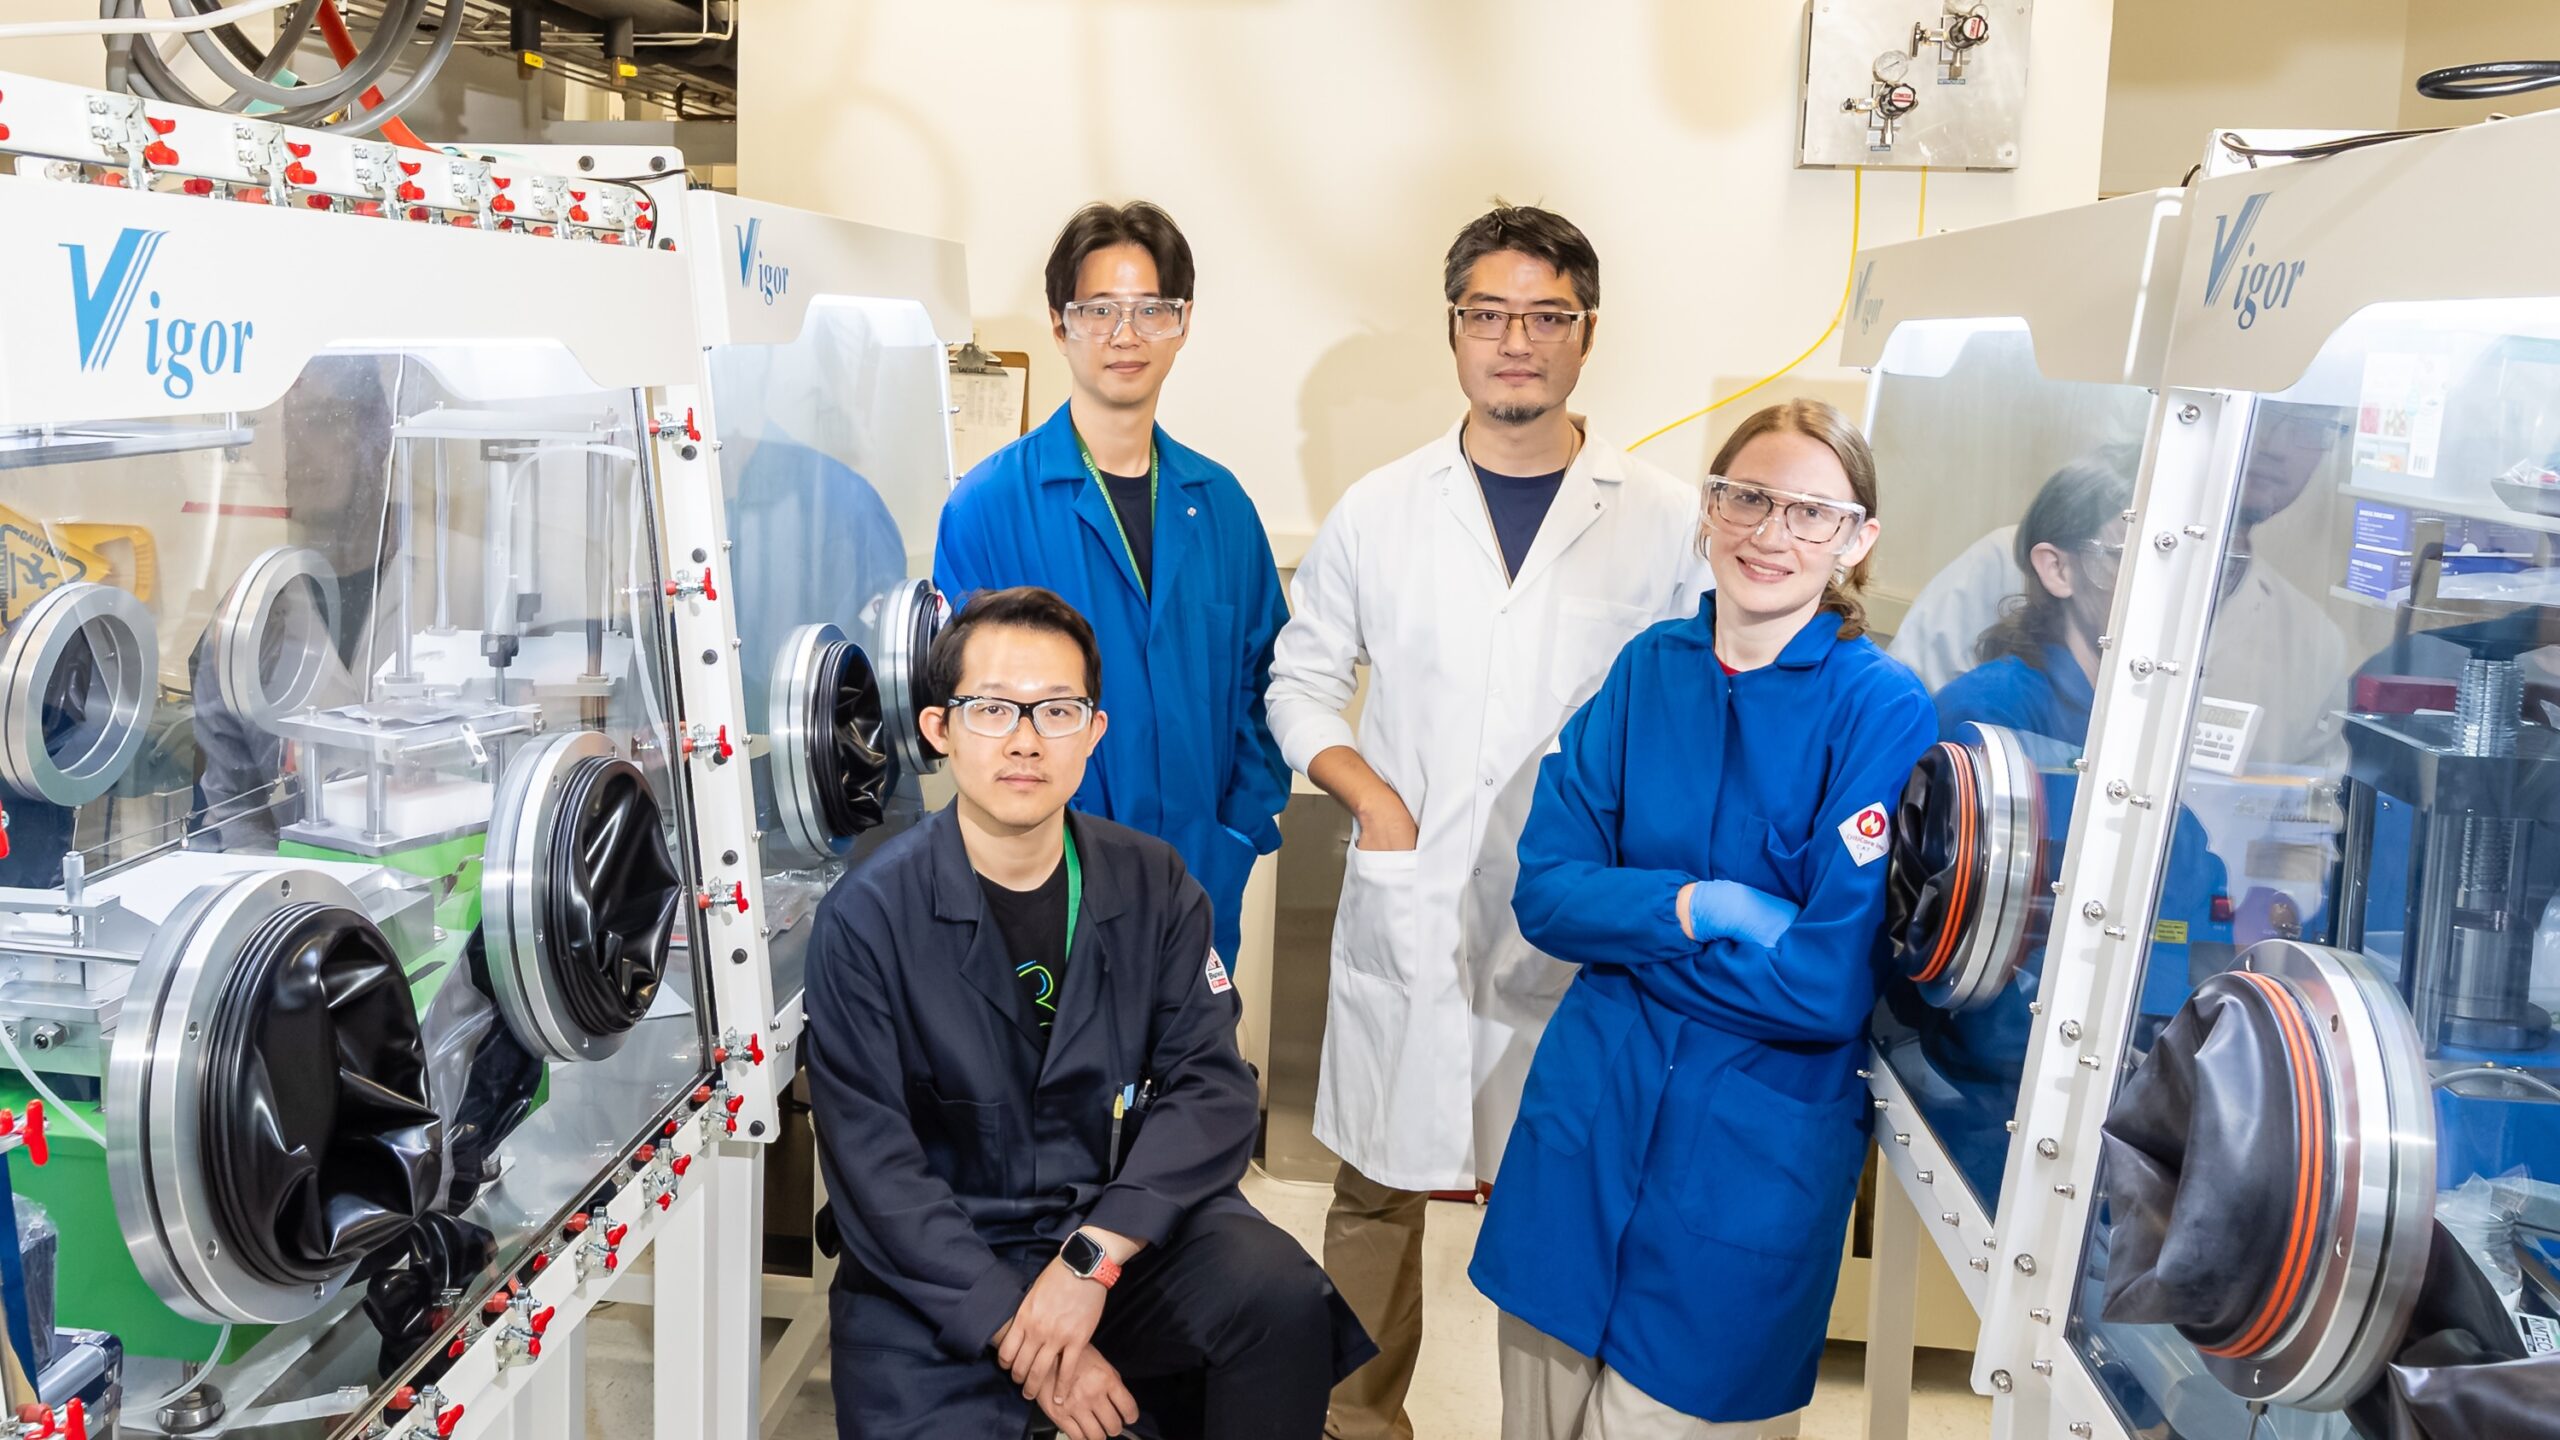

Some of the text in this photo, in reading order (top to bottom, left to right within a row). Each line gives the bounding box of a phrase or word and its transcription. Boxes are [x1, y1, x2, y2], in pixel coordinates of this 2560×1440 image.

[57, 227, 254, 399] Vigor
[733, 217, 789, 306] Vigor
[1853, 259, 1884, 335] Vigor
[2203, 191, 2306, 330] Vigor
